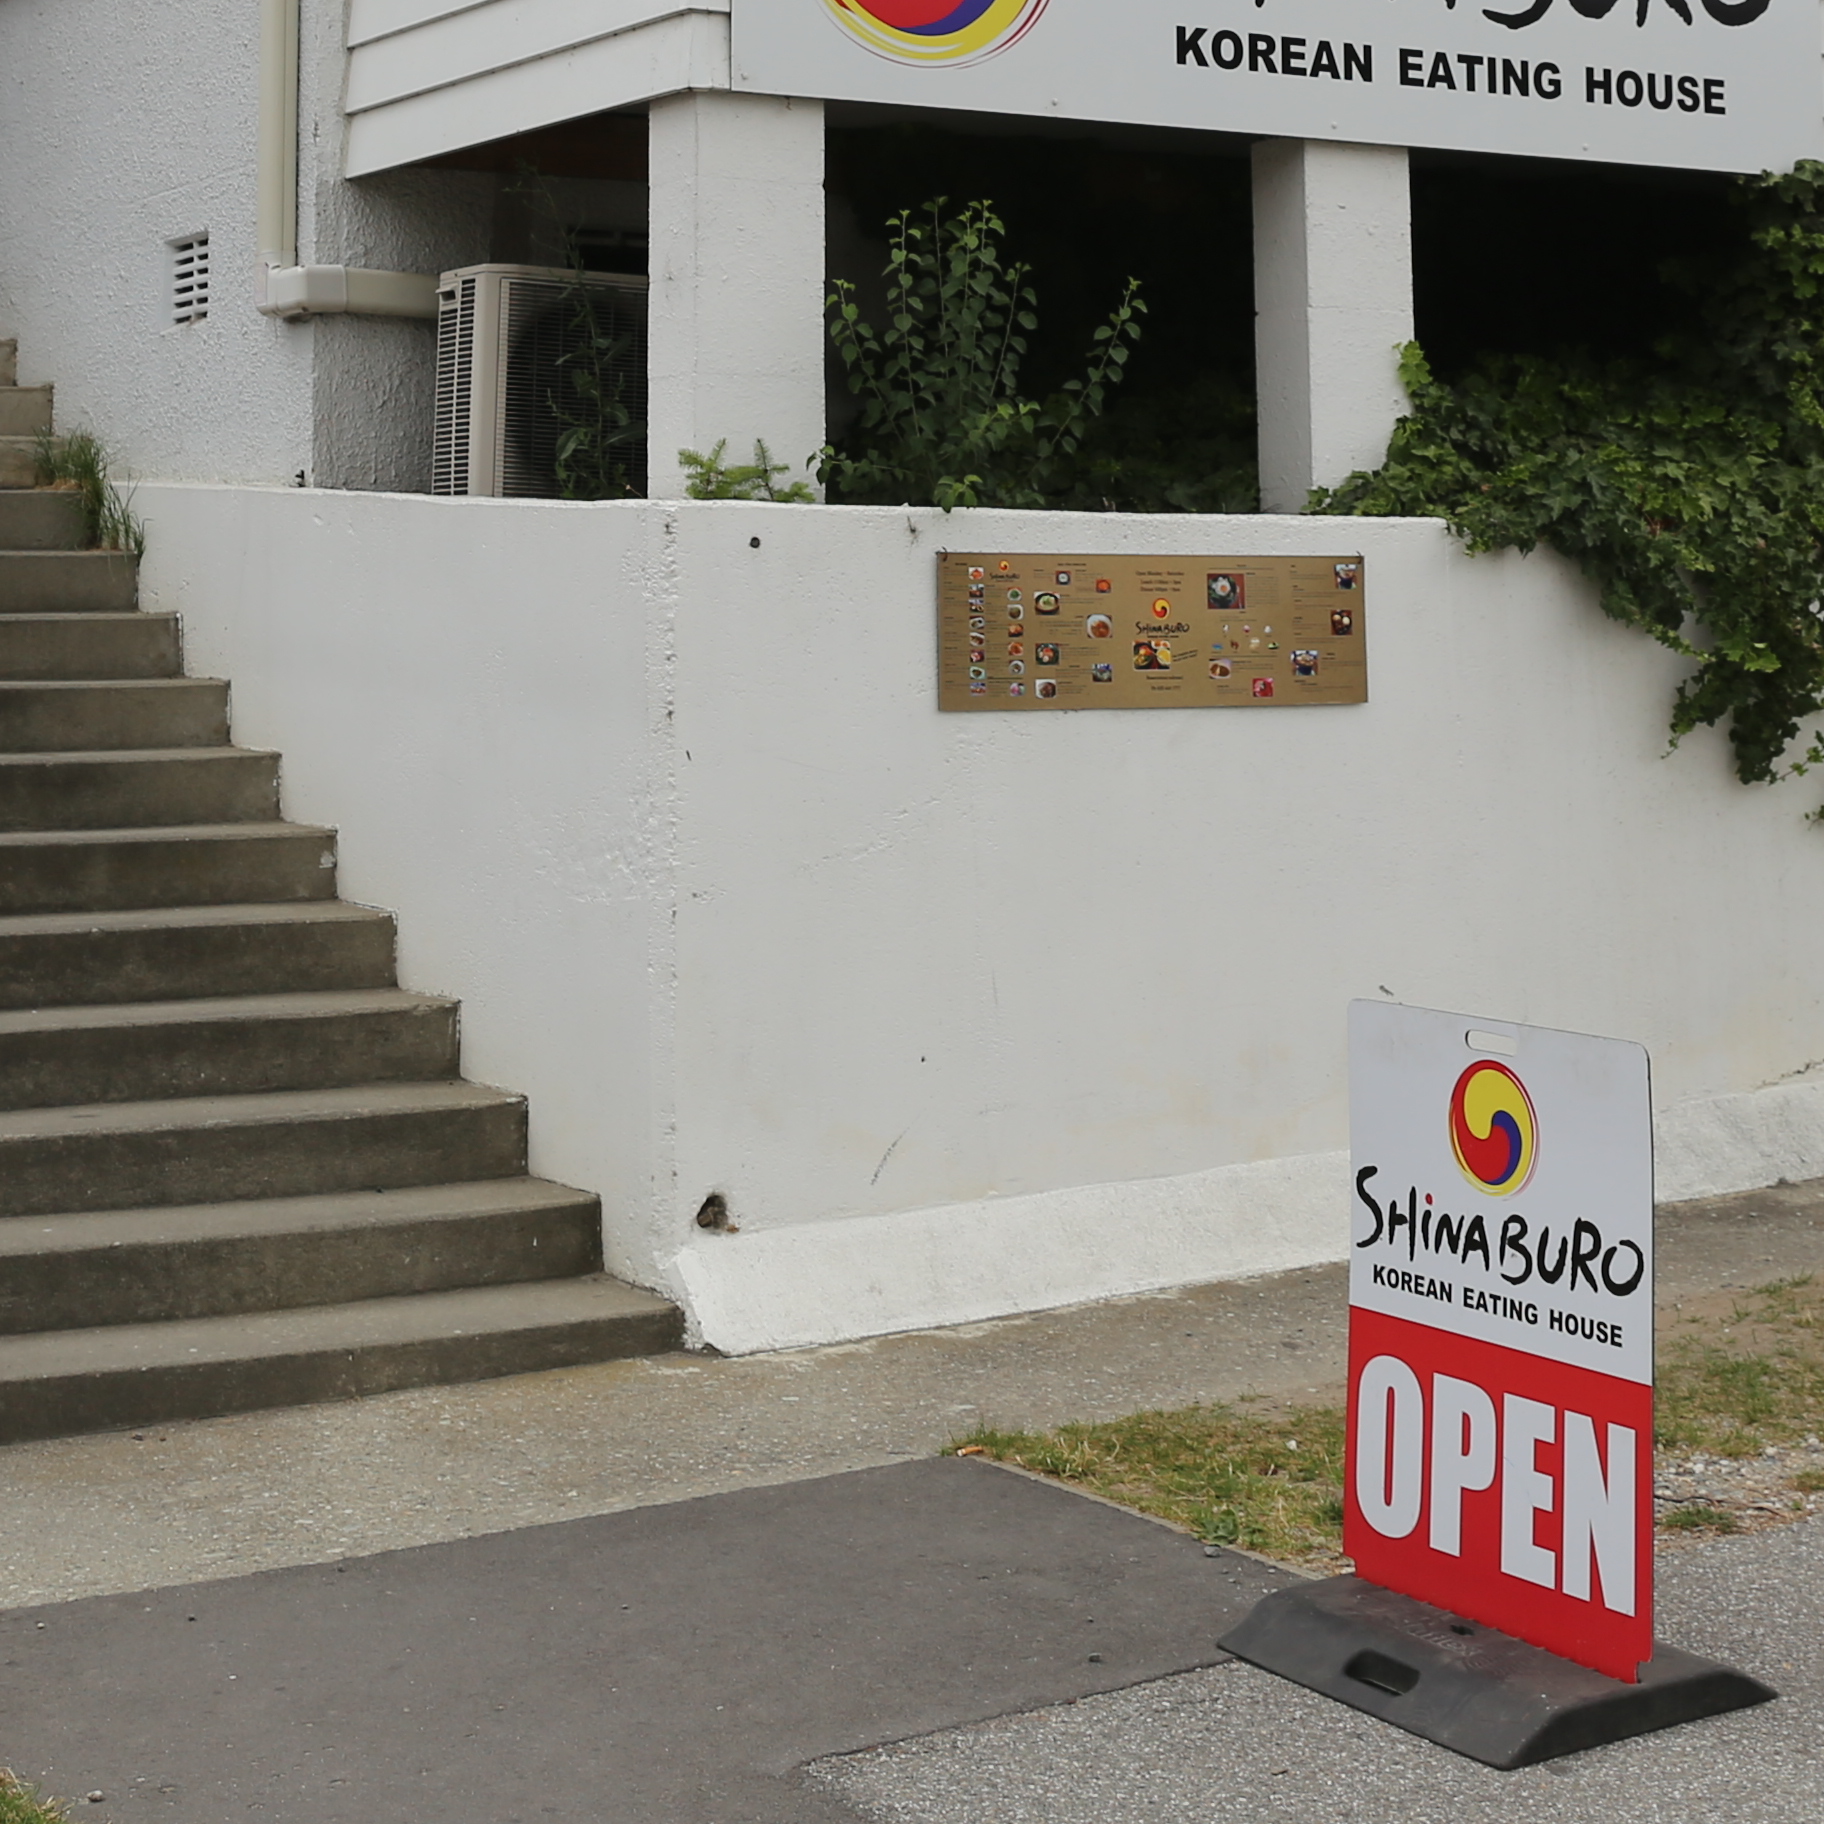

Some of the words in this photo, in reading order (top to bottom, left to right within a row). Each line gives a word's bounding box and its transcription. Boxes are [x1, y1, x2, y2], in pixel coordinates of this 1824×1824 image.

[1176, 25, 1373, 83] KOREAN
[1399, 47, 1562, 100] EATING
[1585, 66, 1727, 116] HOUSE
[1373, 1264, 1452, 1304] KOREAN
[1463, 1286, 1538, 1325] EATING
[1549, 1308, 1623, 1348] HOUSE
[1356, 1355, 1636, 1617] OPEN
